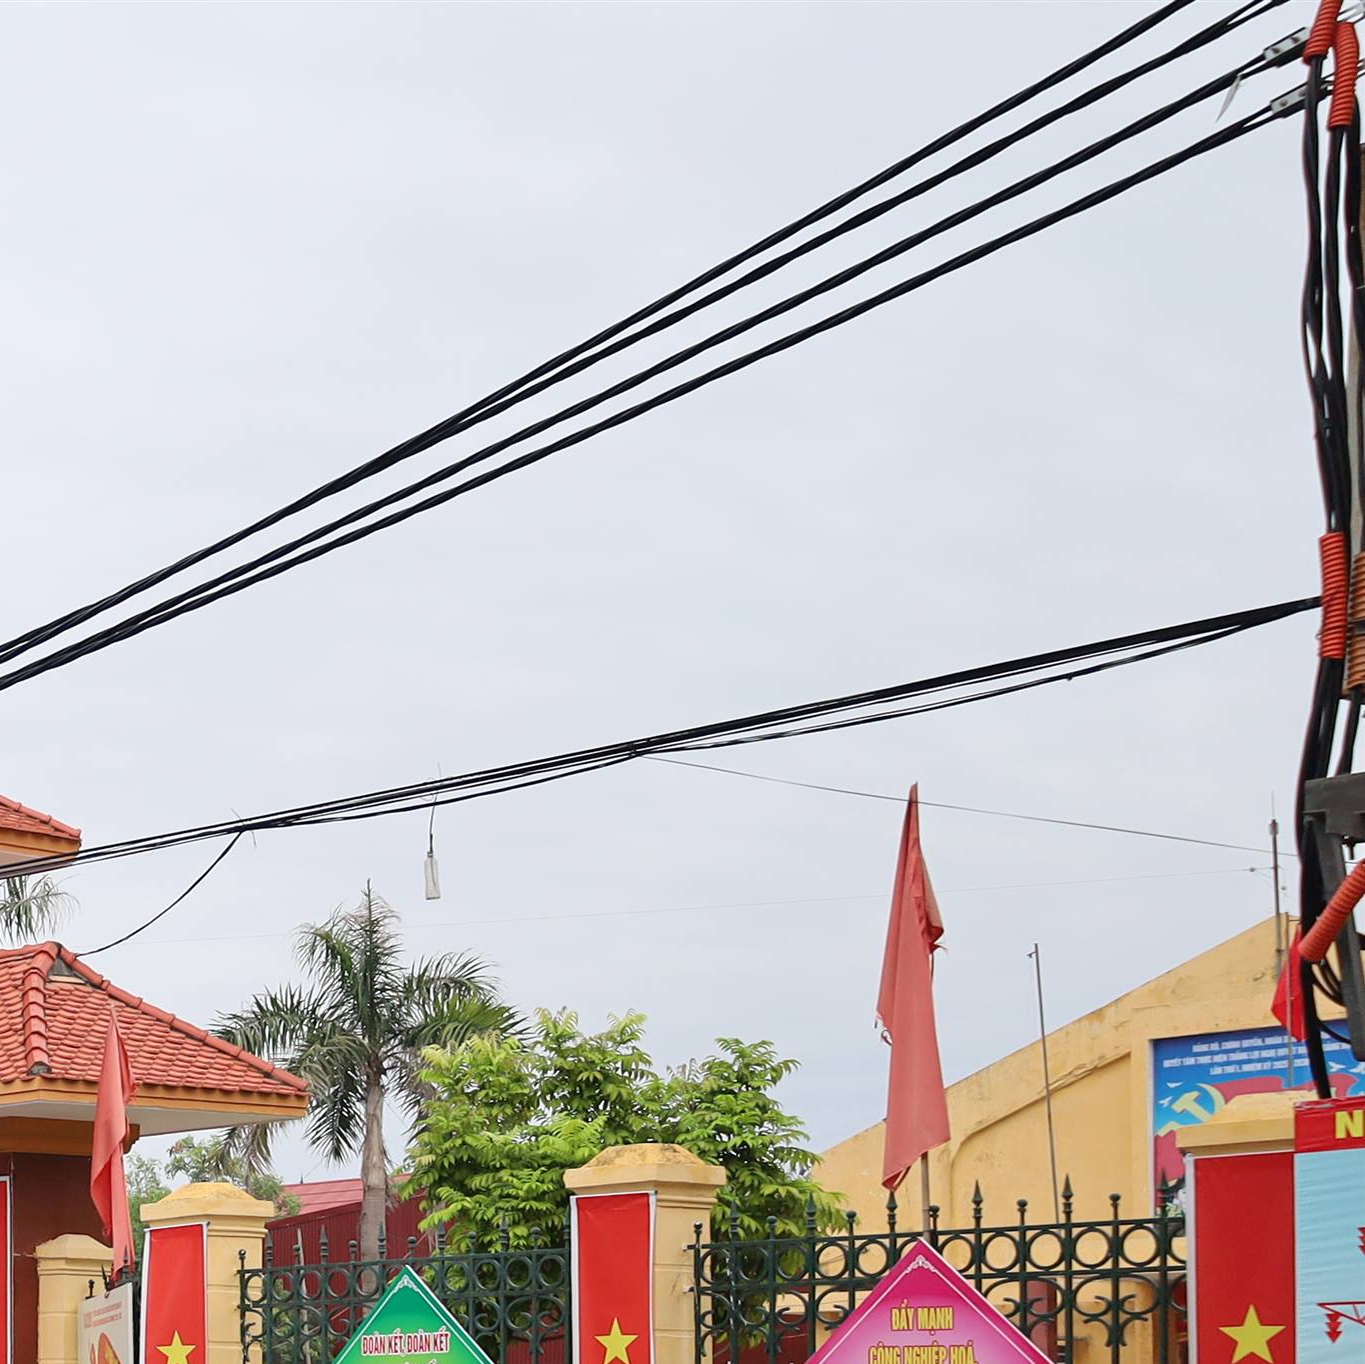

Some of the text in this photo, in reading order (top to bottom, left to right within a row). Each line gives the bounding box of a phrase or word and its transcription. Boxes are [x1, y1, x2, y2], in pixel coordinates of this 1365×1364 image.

[891, 1299, 953, 1335] ĐẨY MẠNH
[362, 1326, 450, 1355] ĐOÀN KẾT, ĐOÀN KẾT
